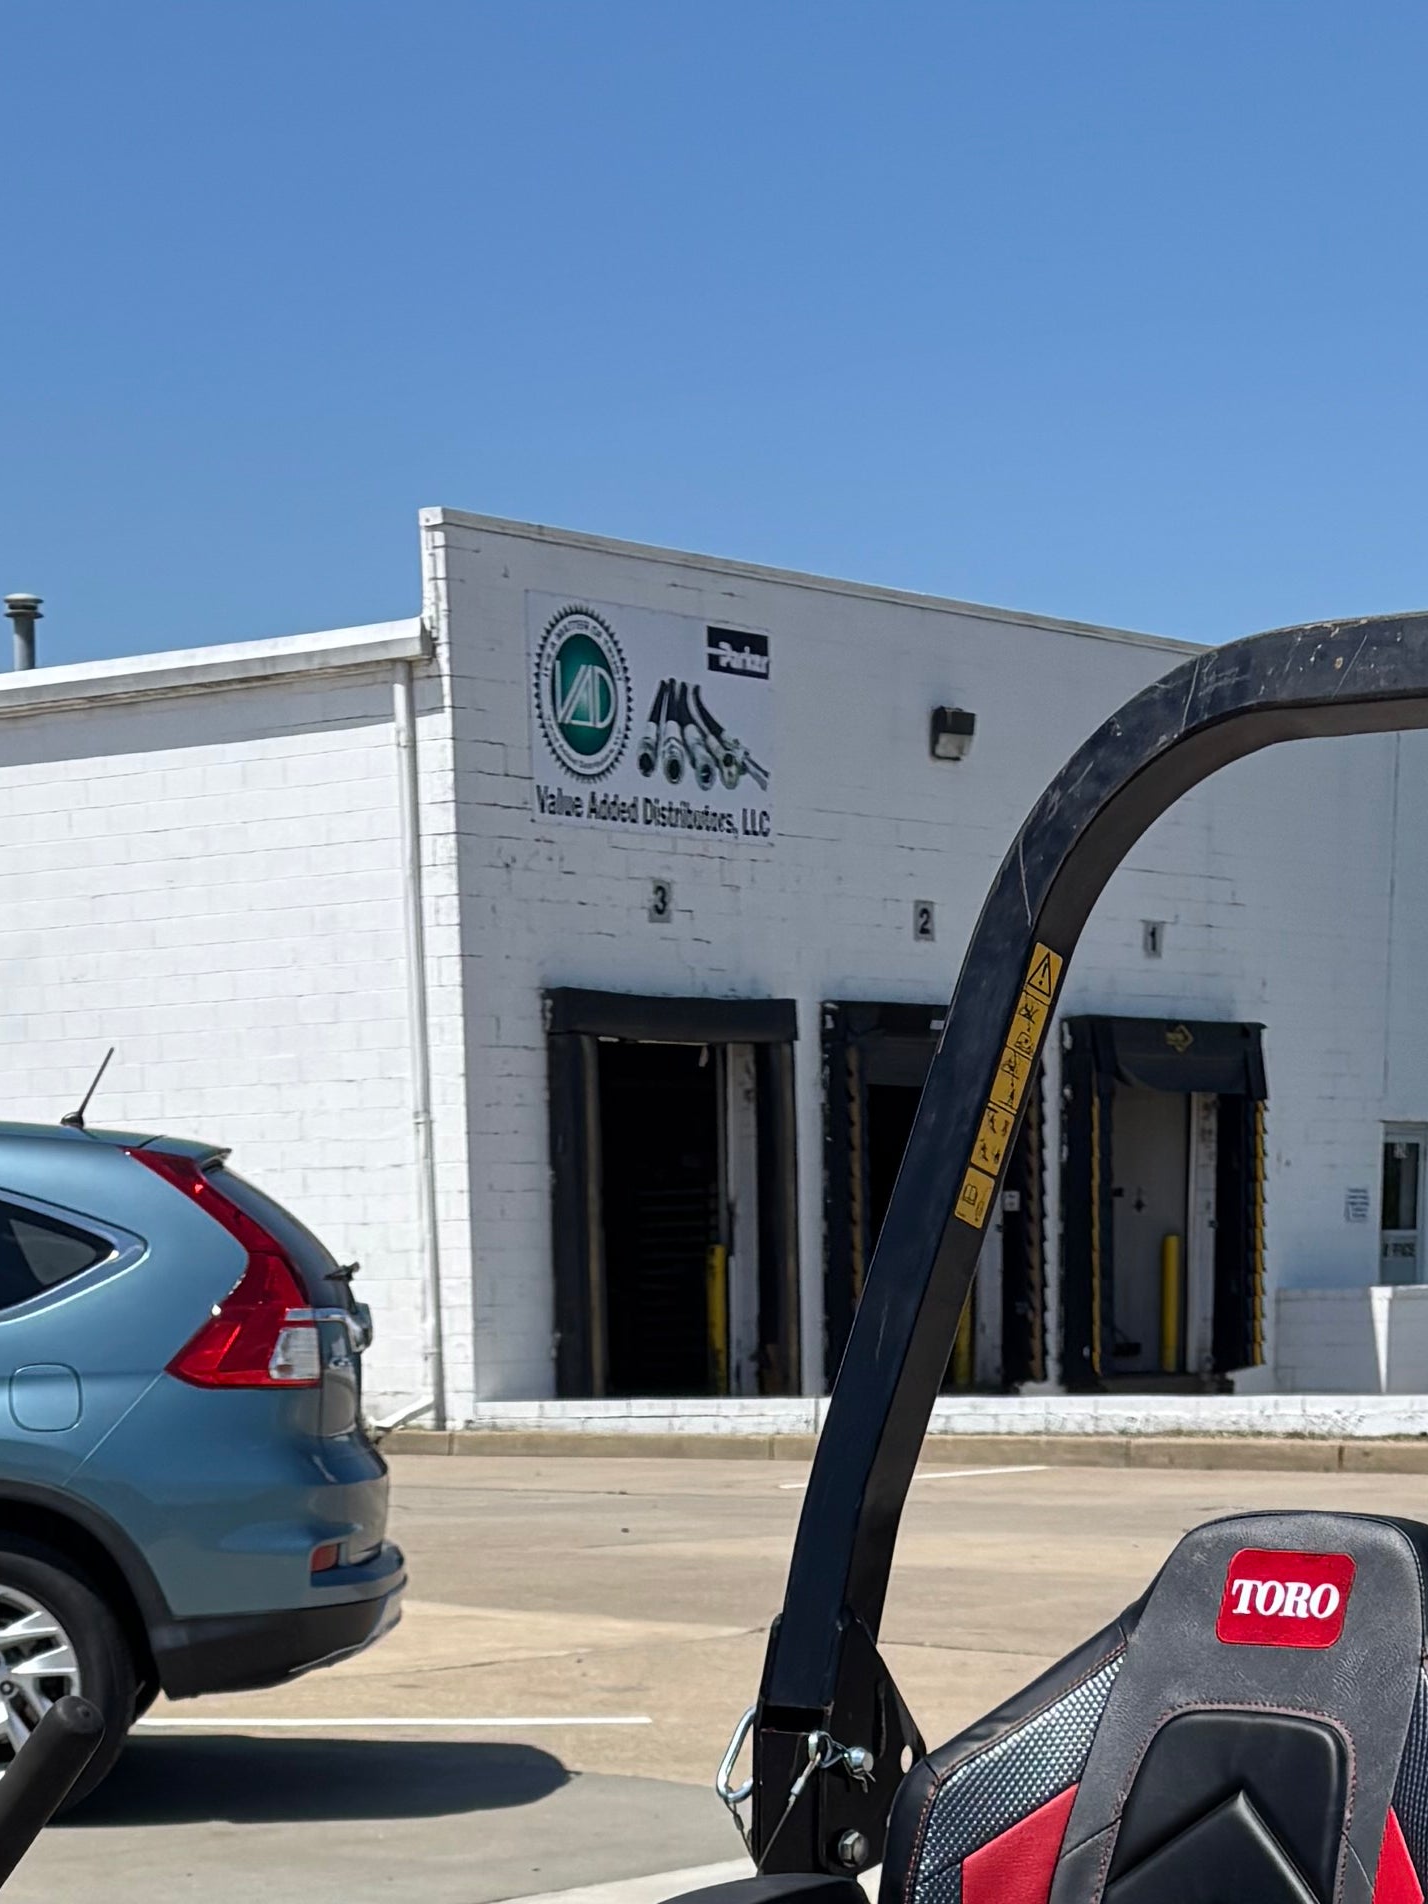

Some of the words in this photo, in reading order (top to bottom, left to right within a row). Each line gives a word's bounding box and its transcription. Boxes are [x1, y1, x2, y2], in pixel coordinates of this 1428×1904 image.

[554, 660, 619, 730] VAD
[535, 785, 584, 818] Value
[587, 791, 640, 825] Added
[642, 797, 739, 840] Distributors,
[742, 807, 771, 838] LLC
[652, 885, 668, 916] 3
[918, 907, 932, 935] 2
[1231, 1578, 1340, 1619] TORO
